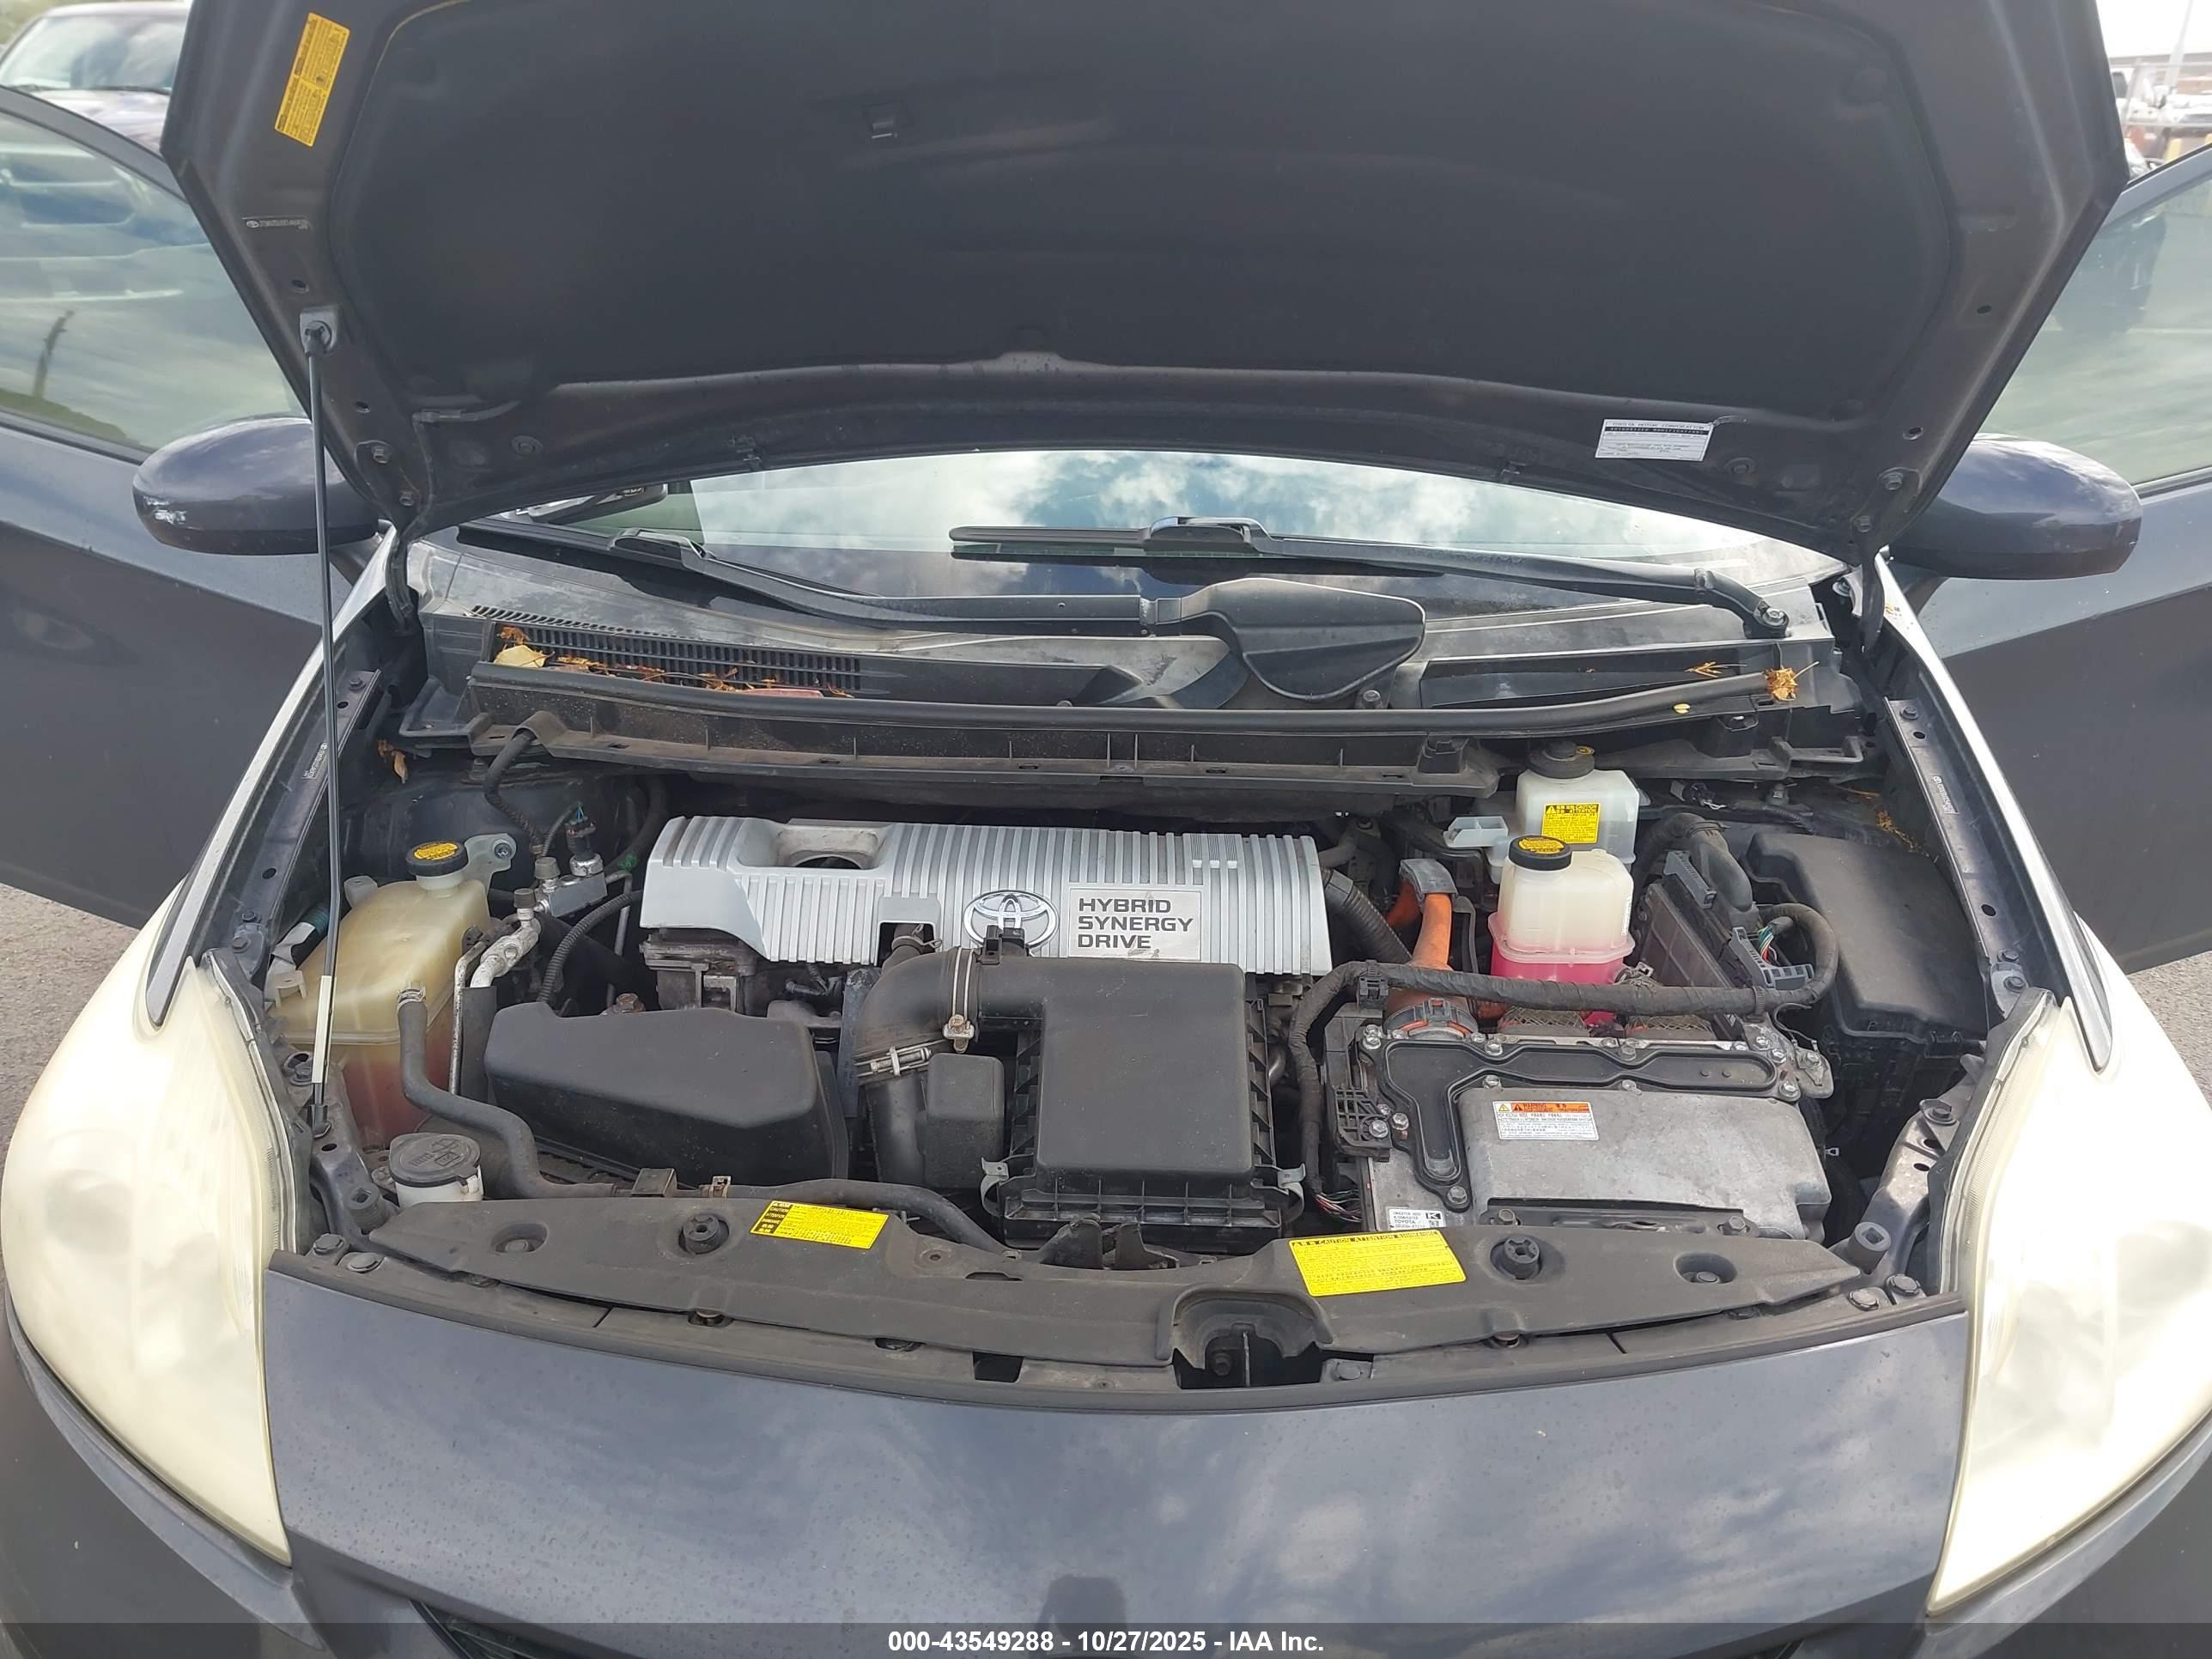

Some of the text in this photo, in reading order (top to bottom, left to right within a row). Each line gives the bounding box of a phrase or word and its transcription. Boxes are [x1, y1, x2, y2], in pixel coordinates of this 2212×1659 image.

[1079, 898, 1171, 913] HYBRID
[1078, 915, 1194, 932] SYNERGY
[1078, 933, 1152, 949] DRIVE
